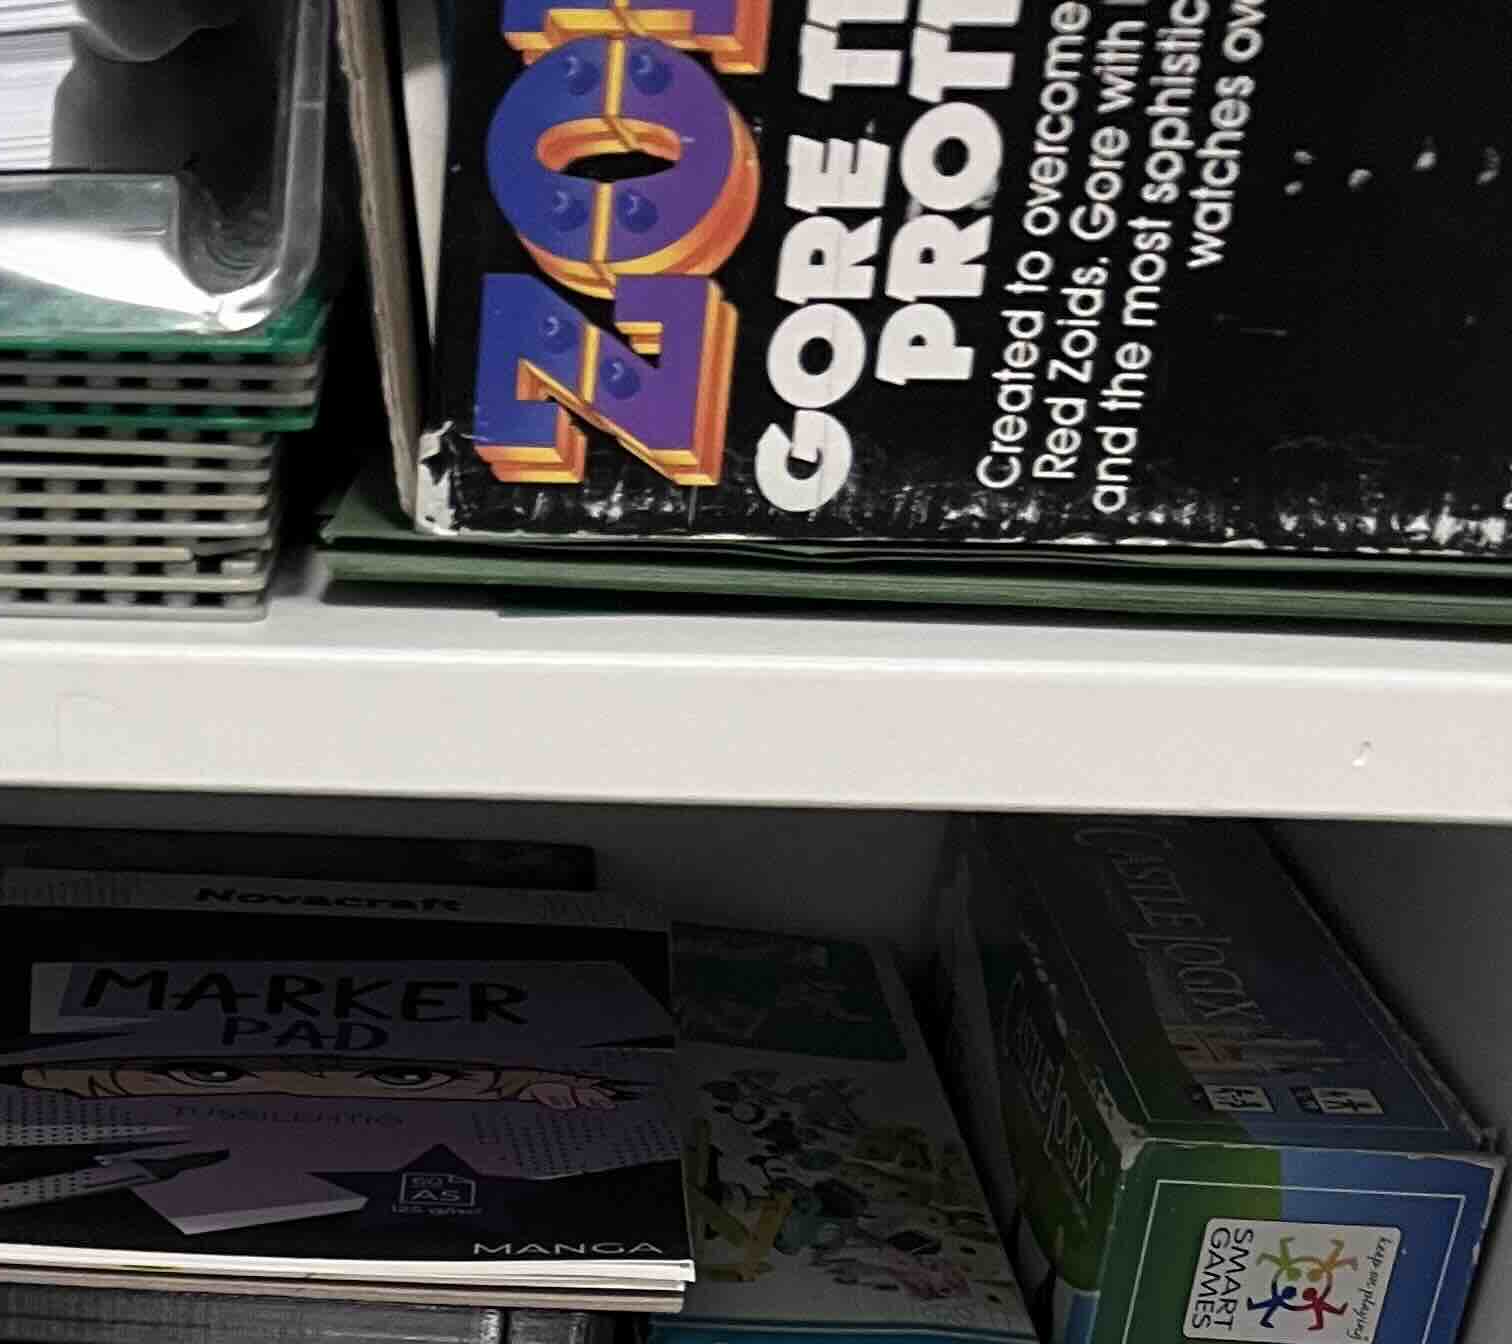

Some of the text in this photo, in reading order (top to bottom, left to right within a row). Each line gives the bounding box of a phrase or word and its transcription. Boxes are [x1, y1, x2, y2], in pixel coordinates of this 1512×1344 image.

[1093, 19, 1148, 114] with
[1068, 126, 1131, 241] Gore
[1186, 75, 1256, 268] watches
[474, 0, 767, 485] ZO
[975, 1, 1092, 489] Created to overcome
[1121, 215, 1173, 327] most
[755, 134, 890, 512] GORE
[1046, 256, 1111, 383] Zoids.
[1097, 341, 1153, 411] the
[1031, 397, 1088, 479] Red
[1092, 425, 1138, 514] and
[84, 967, 529, 1025] MARKER
[221, 1016, 389, 1052] PAD
[473, 1242, 664, 1255] MANGA
[1191, 1226, 1232, 1330] GAMES
[1213, 1227, 1254, 1331] SMART
[1346, 1287, 1374, 1342] playing
